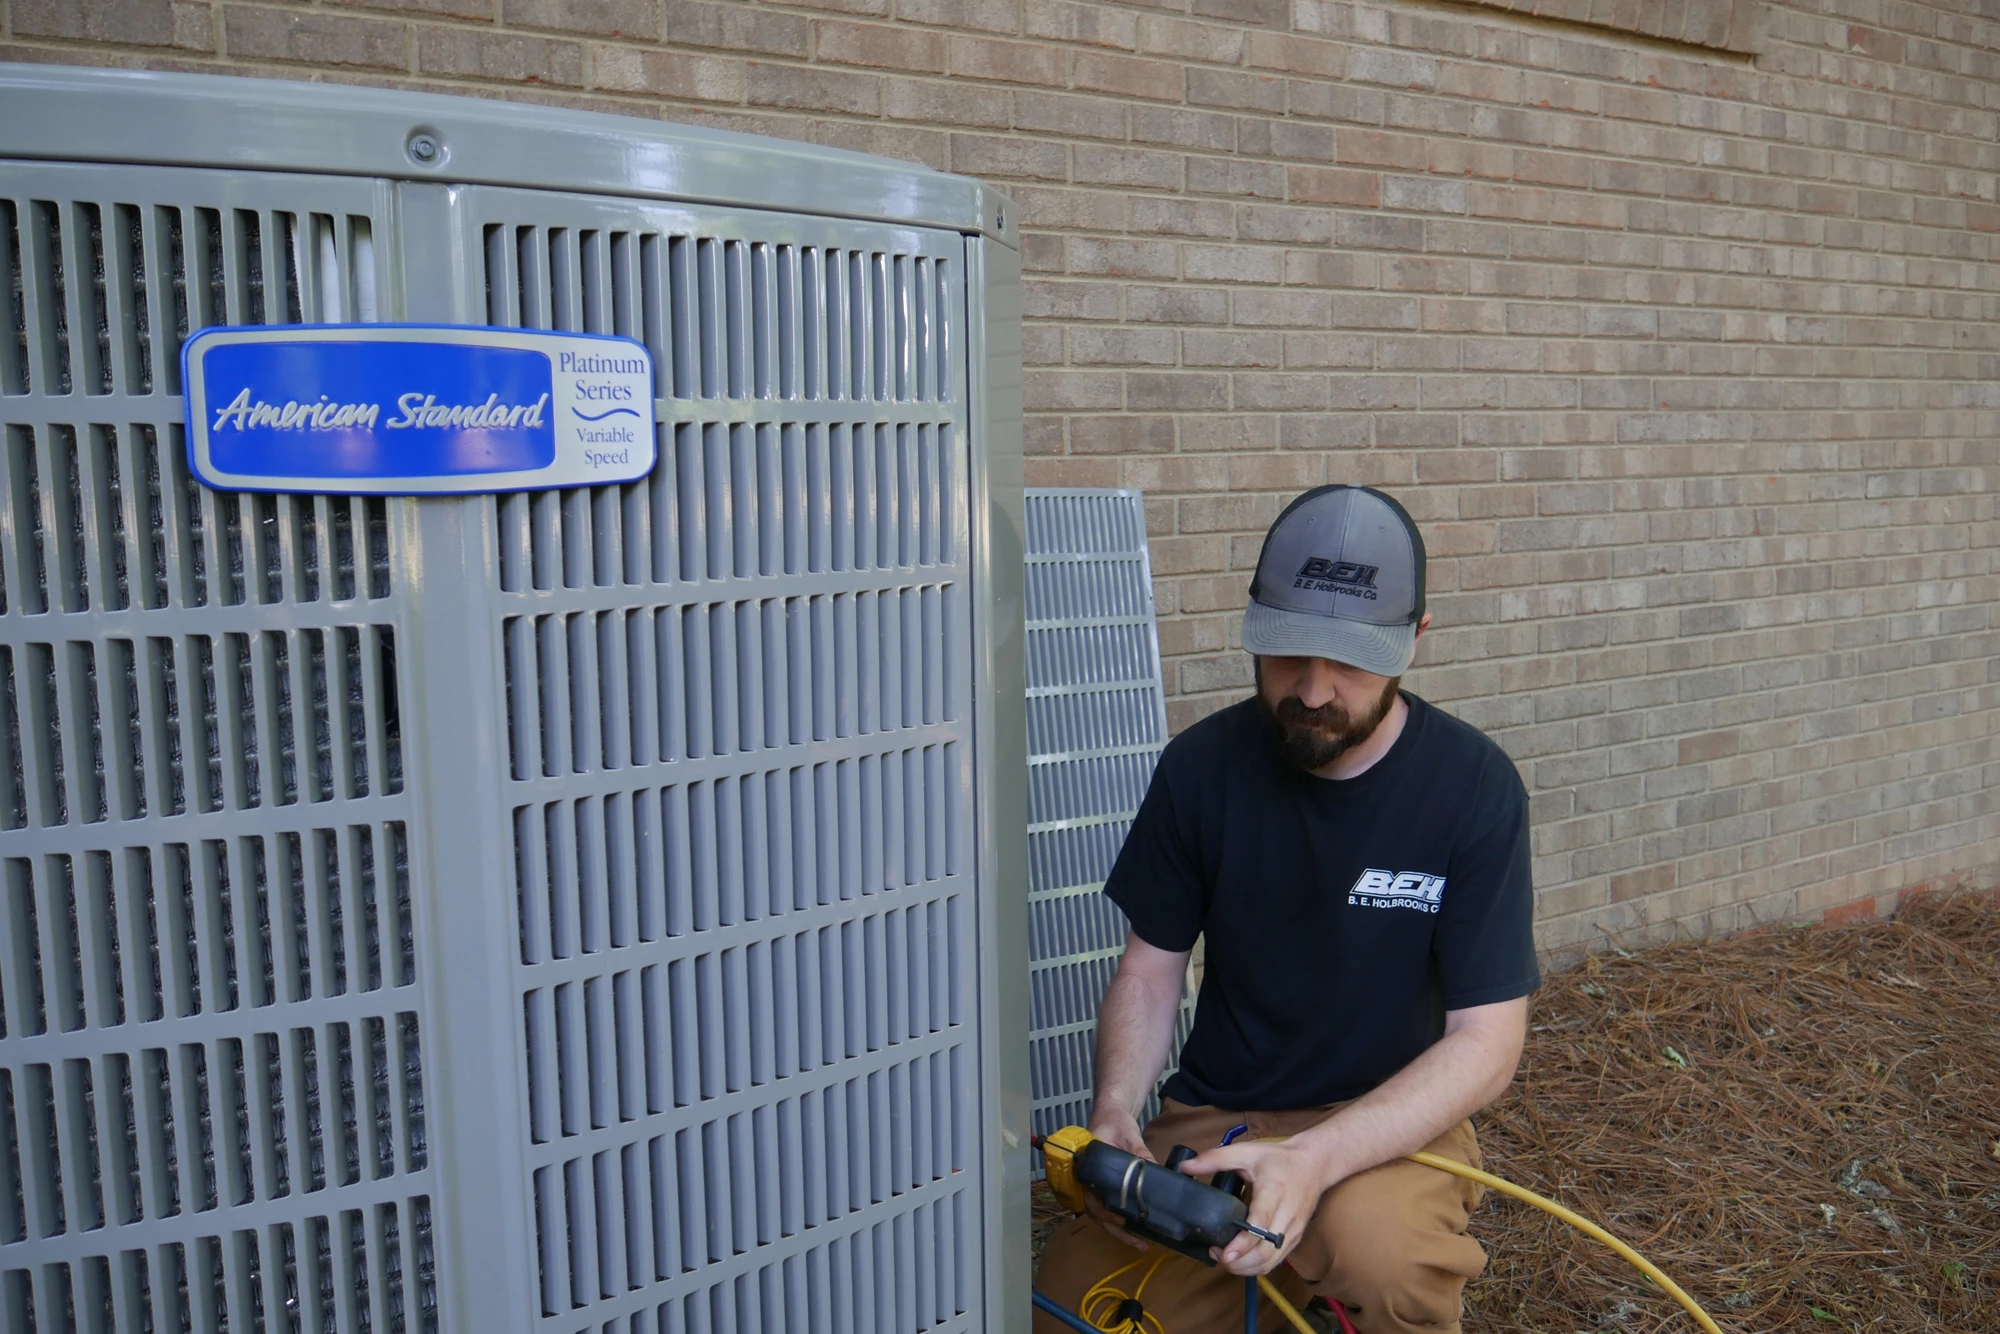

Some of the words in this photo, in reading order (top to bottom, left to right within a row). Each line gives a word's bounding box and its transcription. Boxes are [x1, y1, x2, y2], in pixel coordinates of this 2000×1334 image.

[559, 351, 645, 374] Platinum
[575, 379, 632, 400] Series
[213, 387, 378, 431] American
[387, 392, 548, 429] Standard
[576, 427, 634, 443] Variable
[584, 448, 629, 468] Speed
[1296, 556, 1379, 589] BEH
[1314, 581, 1363, 598] Holbrooks
[1349, 868, 1447, 903] BEH
[1348, 895, 1358, 905] B.
[1360, 896, 1370, 907] E.
[1372, 898, 1429, 913] HOLBROOKS
